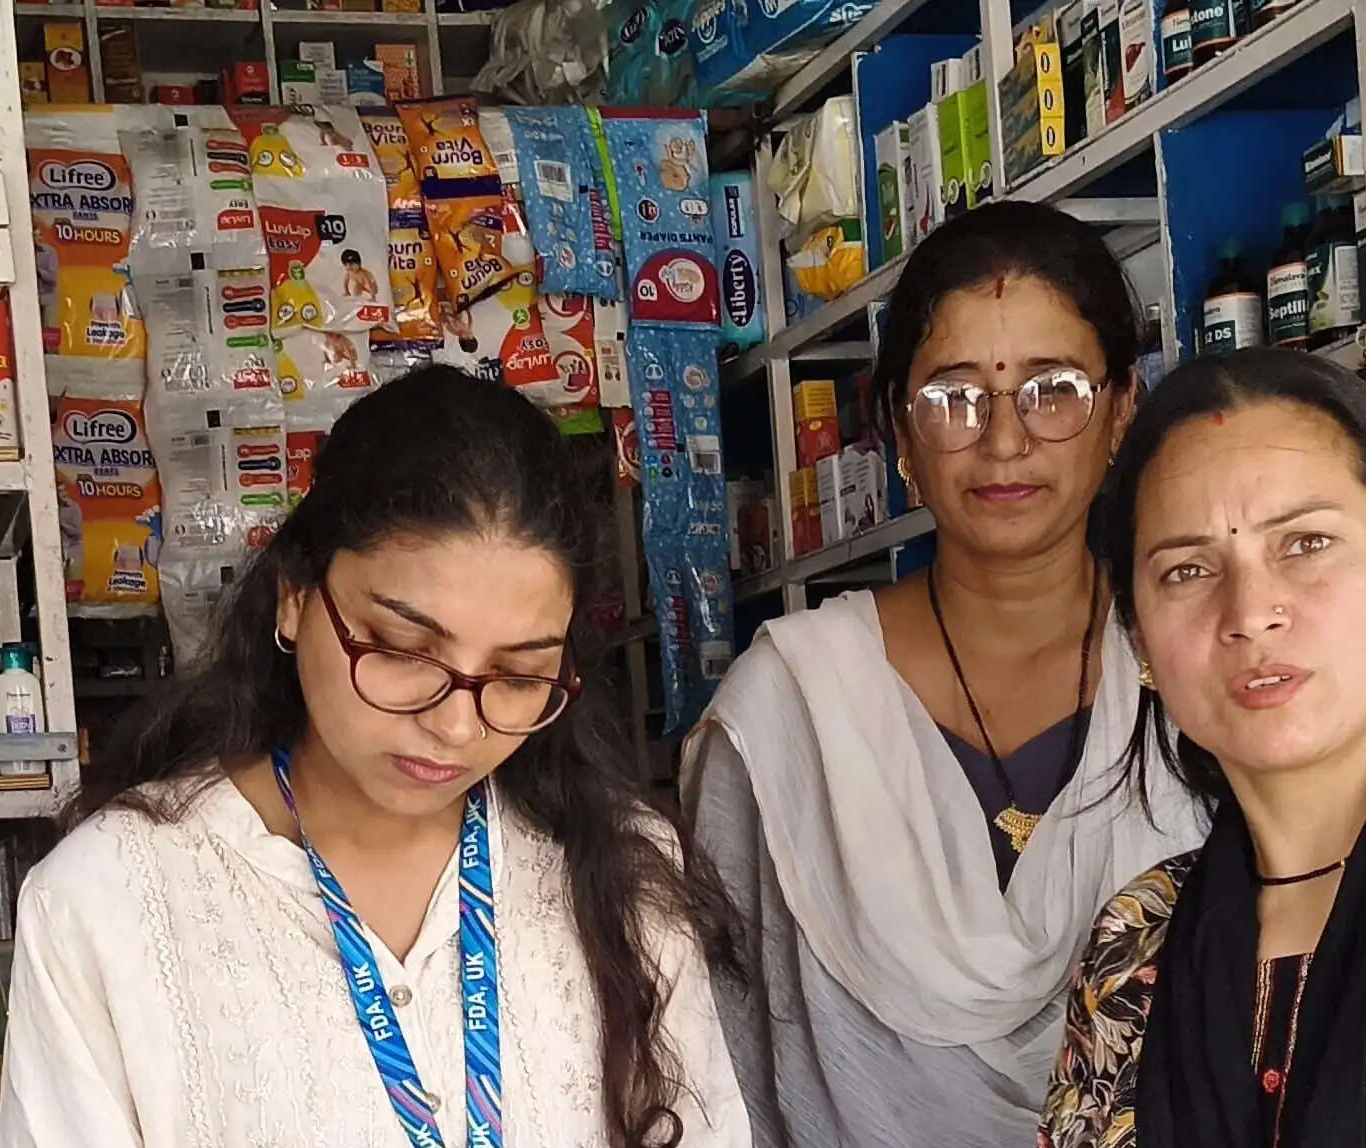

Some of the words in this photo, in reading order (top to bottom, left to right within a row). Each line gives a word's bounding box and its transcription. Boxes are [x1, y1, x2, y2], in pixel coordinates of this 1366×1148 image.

[370, 134, 407, 147] Vita
[436, 138, 473, 150] Vita
[432, 150, 483, 165] Bourn
[50, 169, 104, 185] Lifree
[31, 193, 71, 209] XTRA
[55, 224, 72, 239] 10
[74, 230, 120, 244] HOURS
[265, 220, 311, 239] LuvLap
[640, 286, 656, 298] 10
[729, 252, 749, 326] Liberty
[73, 421, 125, 438] Lifree
[55, 446, 93, 465] XTRA
[101, 449, 155, 466] ABSOR
[78, 480, 94, 496] 10
[96, 484, 140, 497] HOURS
[466, 951, 485, 978] UK
